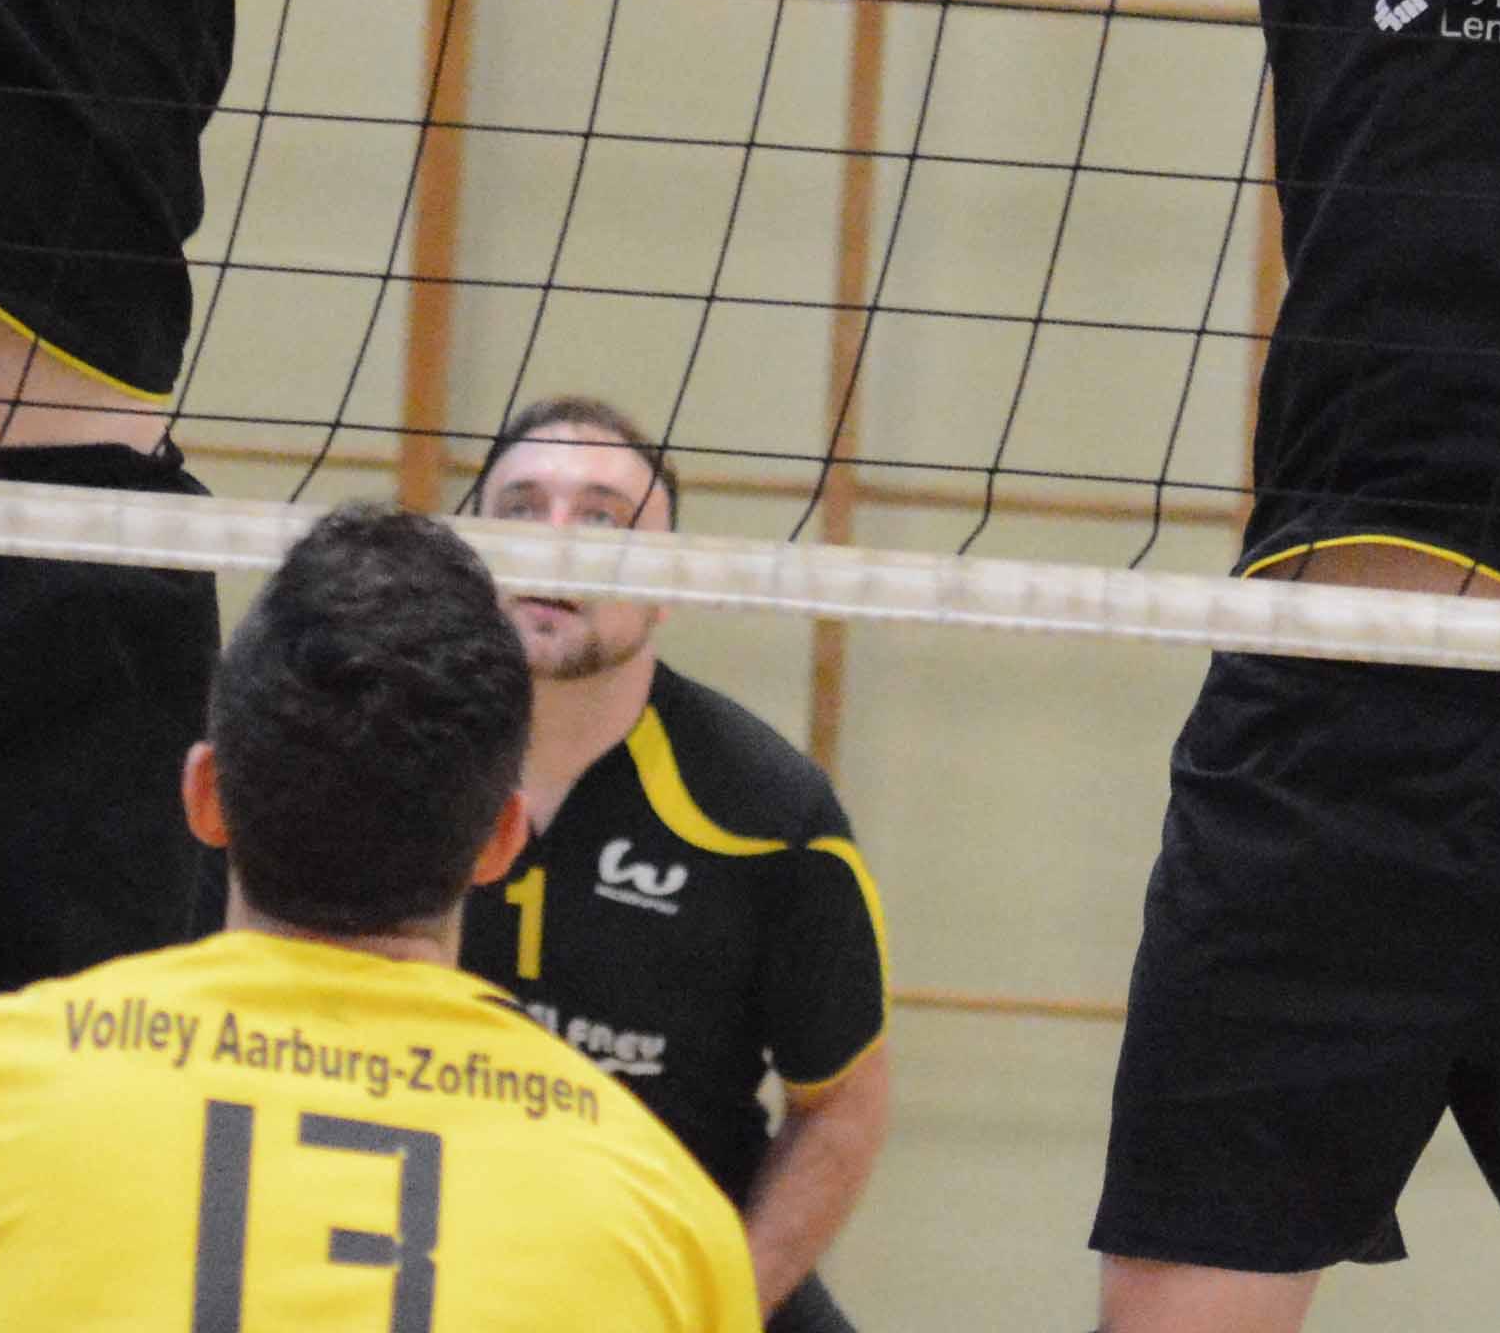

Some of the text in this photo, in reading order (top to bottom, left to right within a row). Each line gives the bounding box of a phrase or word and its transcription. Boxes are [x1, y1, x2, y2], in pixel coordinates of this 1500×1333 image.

[505, 867, 545, 980] 1
[66, 997, 599, 1124] Volley Aarburg-Zofingen
[191, 1098, 442, 1333] 13
